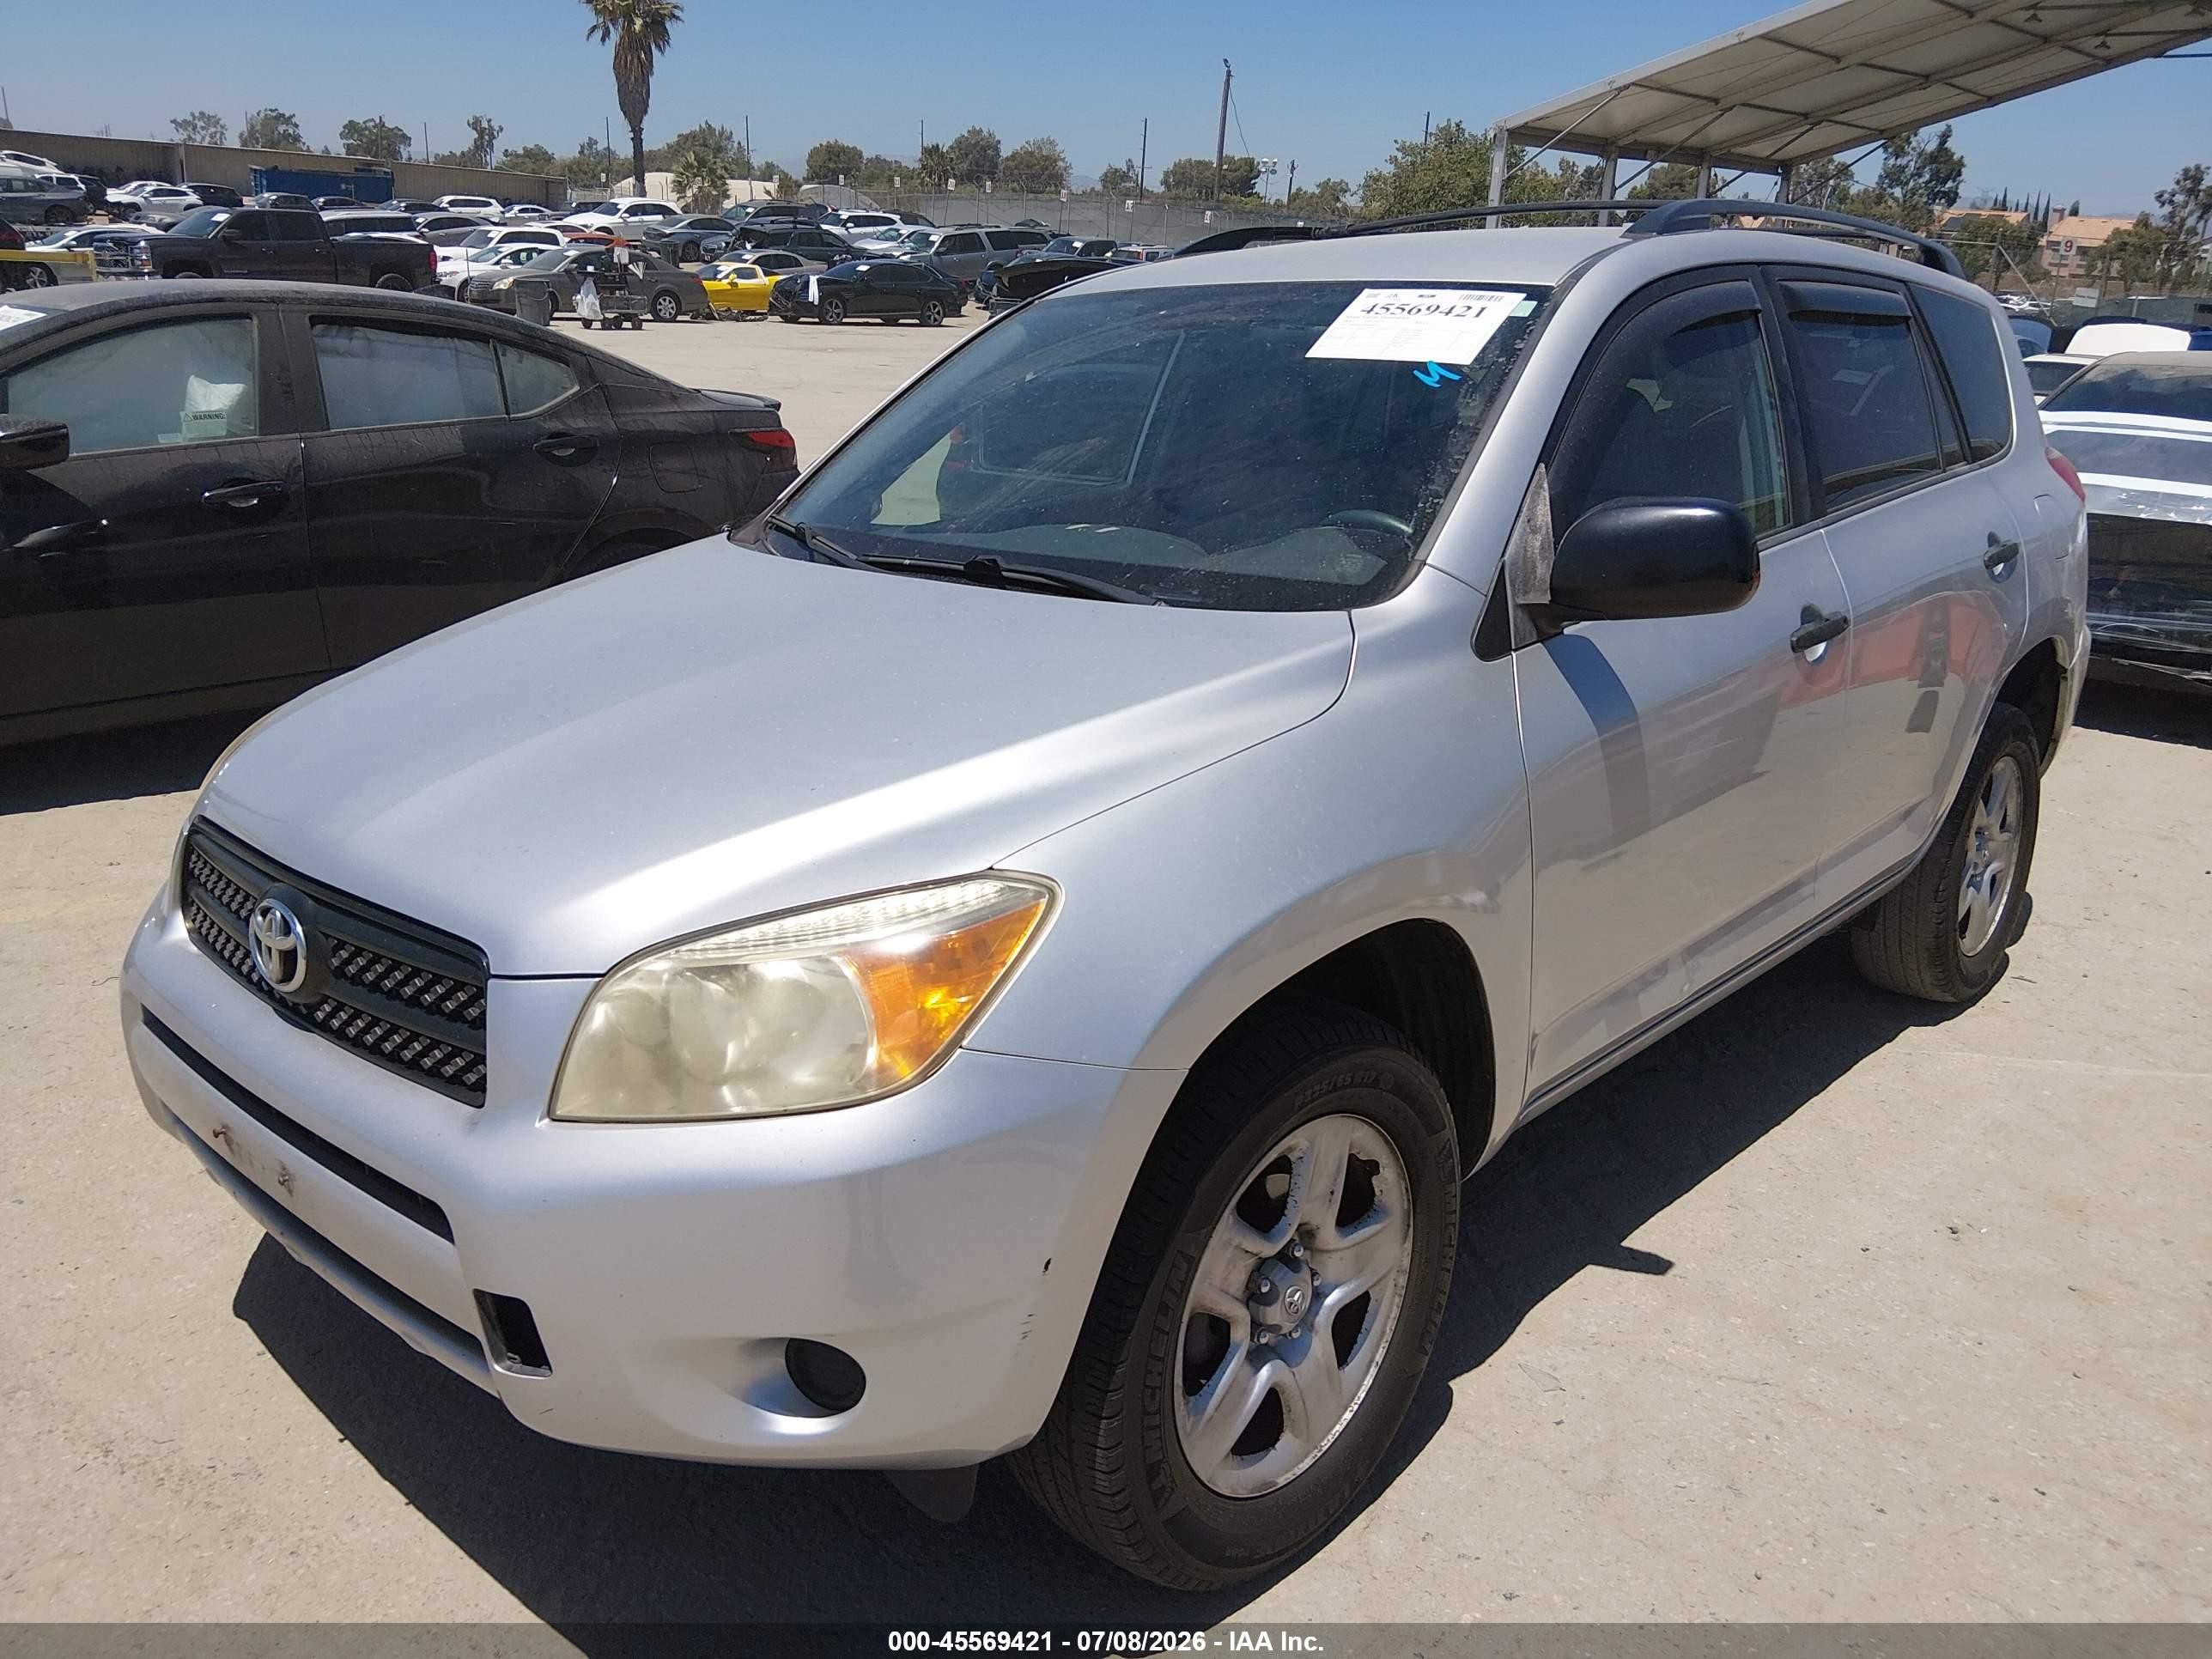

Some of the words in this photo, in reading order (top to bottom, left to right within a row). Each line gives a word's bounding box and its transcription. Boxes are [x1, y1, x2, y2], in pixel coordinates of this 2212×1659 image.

[2063, 240, 2074, 253] 9
[1360, 302, 1488, 319] 45569421
[1141, 1249, 1196, 1465] MICHELIN
